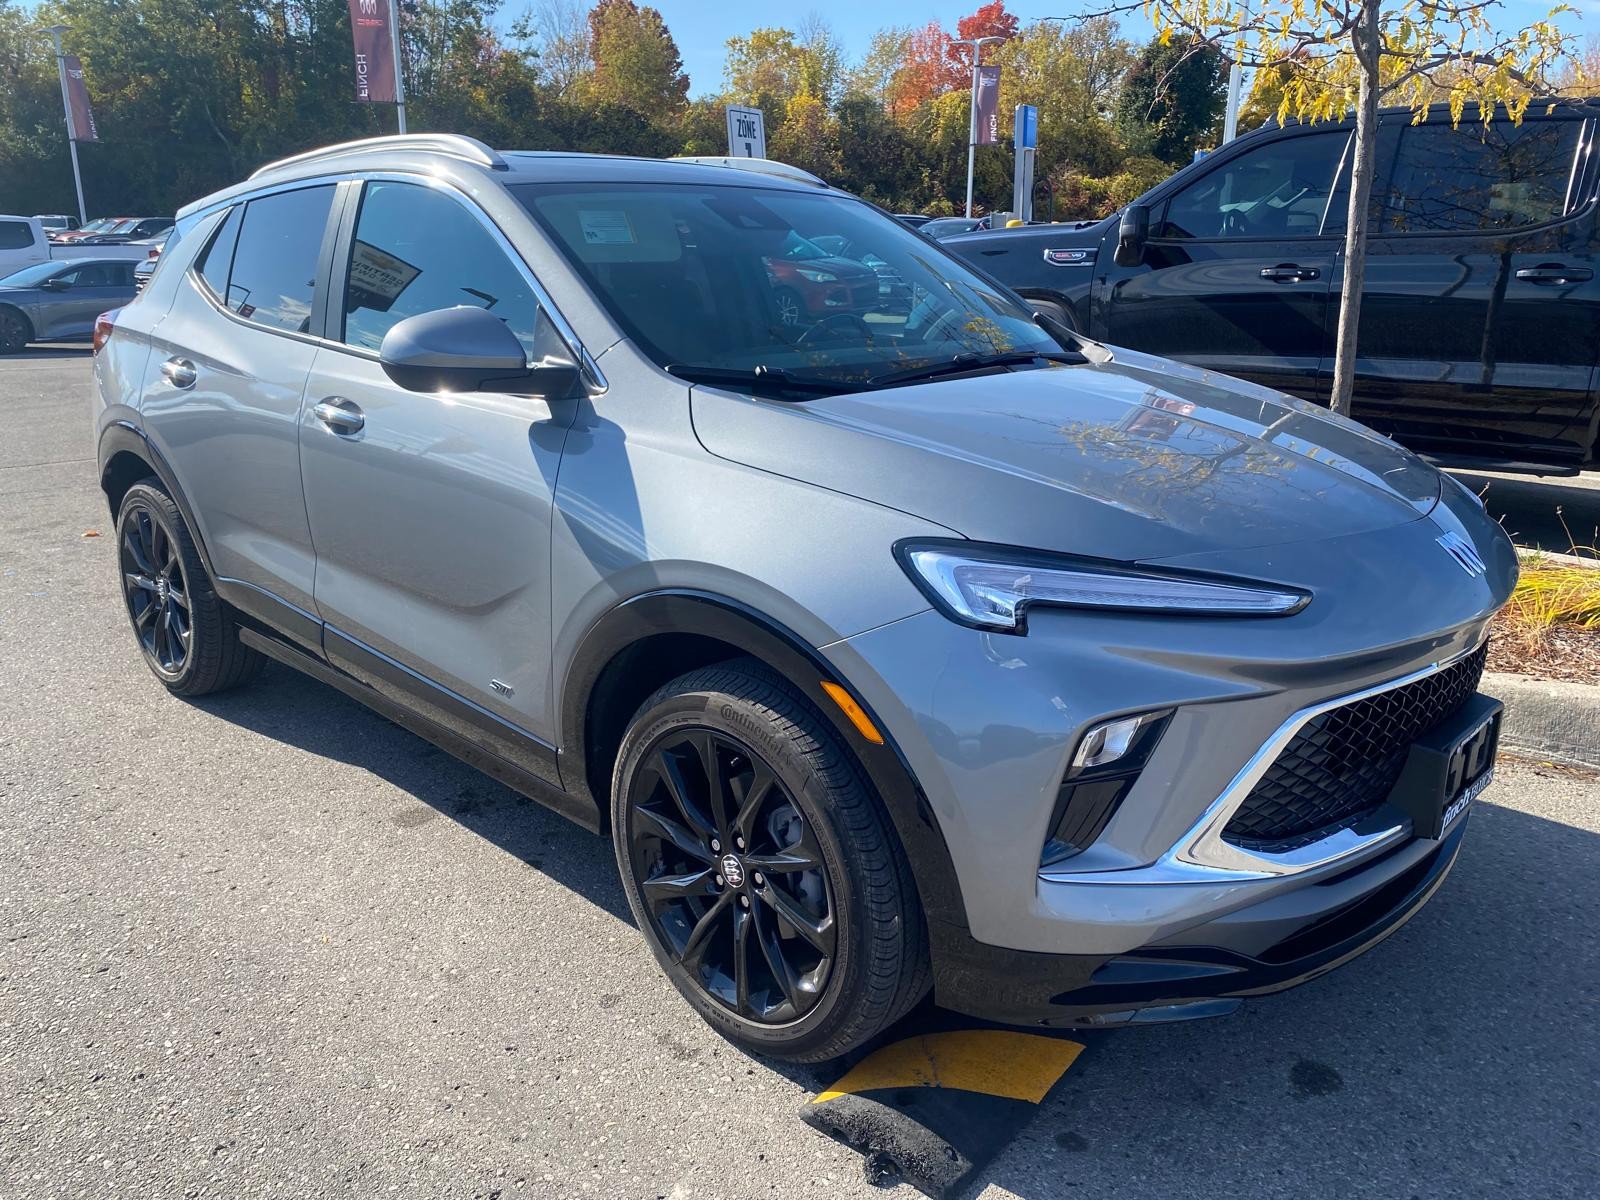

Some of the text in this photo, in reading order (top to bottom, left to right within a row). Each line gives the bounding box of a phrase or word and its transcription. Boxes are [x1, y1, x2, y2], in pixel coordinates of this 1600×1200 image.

[736, 118, 757, 140] ZONE
[990, 114, 998, 142] FINCH
[720, 704, 785, 757] Continental
[1439, 787, 1471, 839] finch
